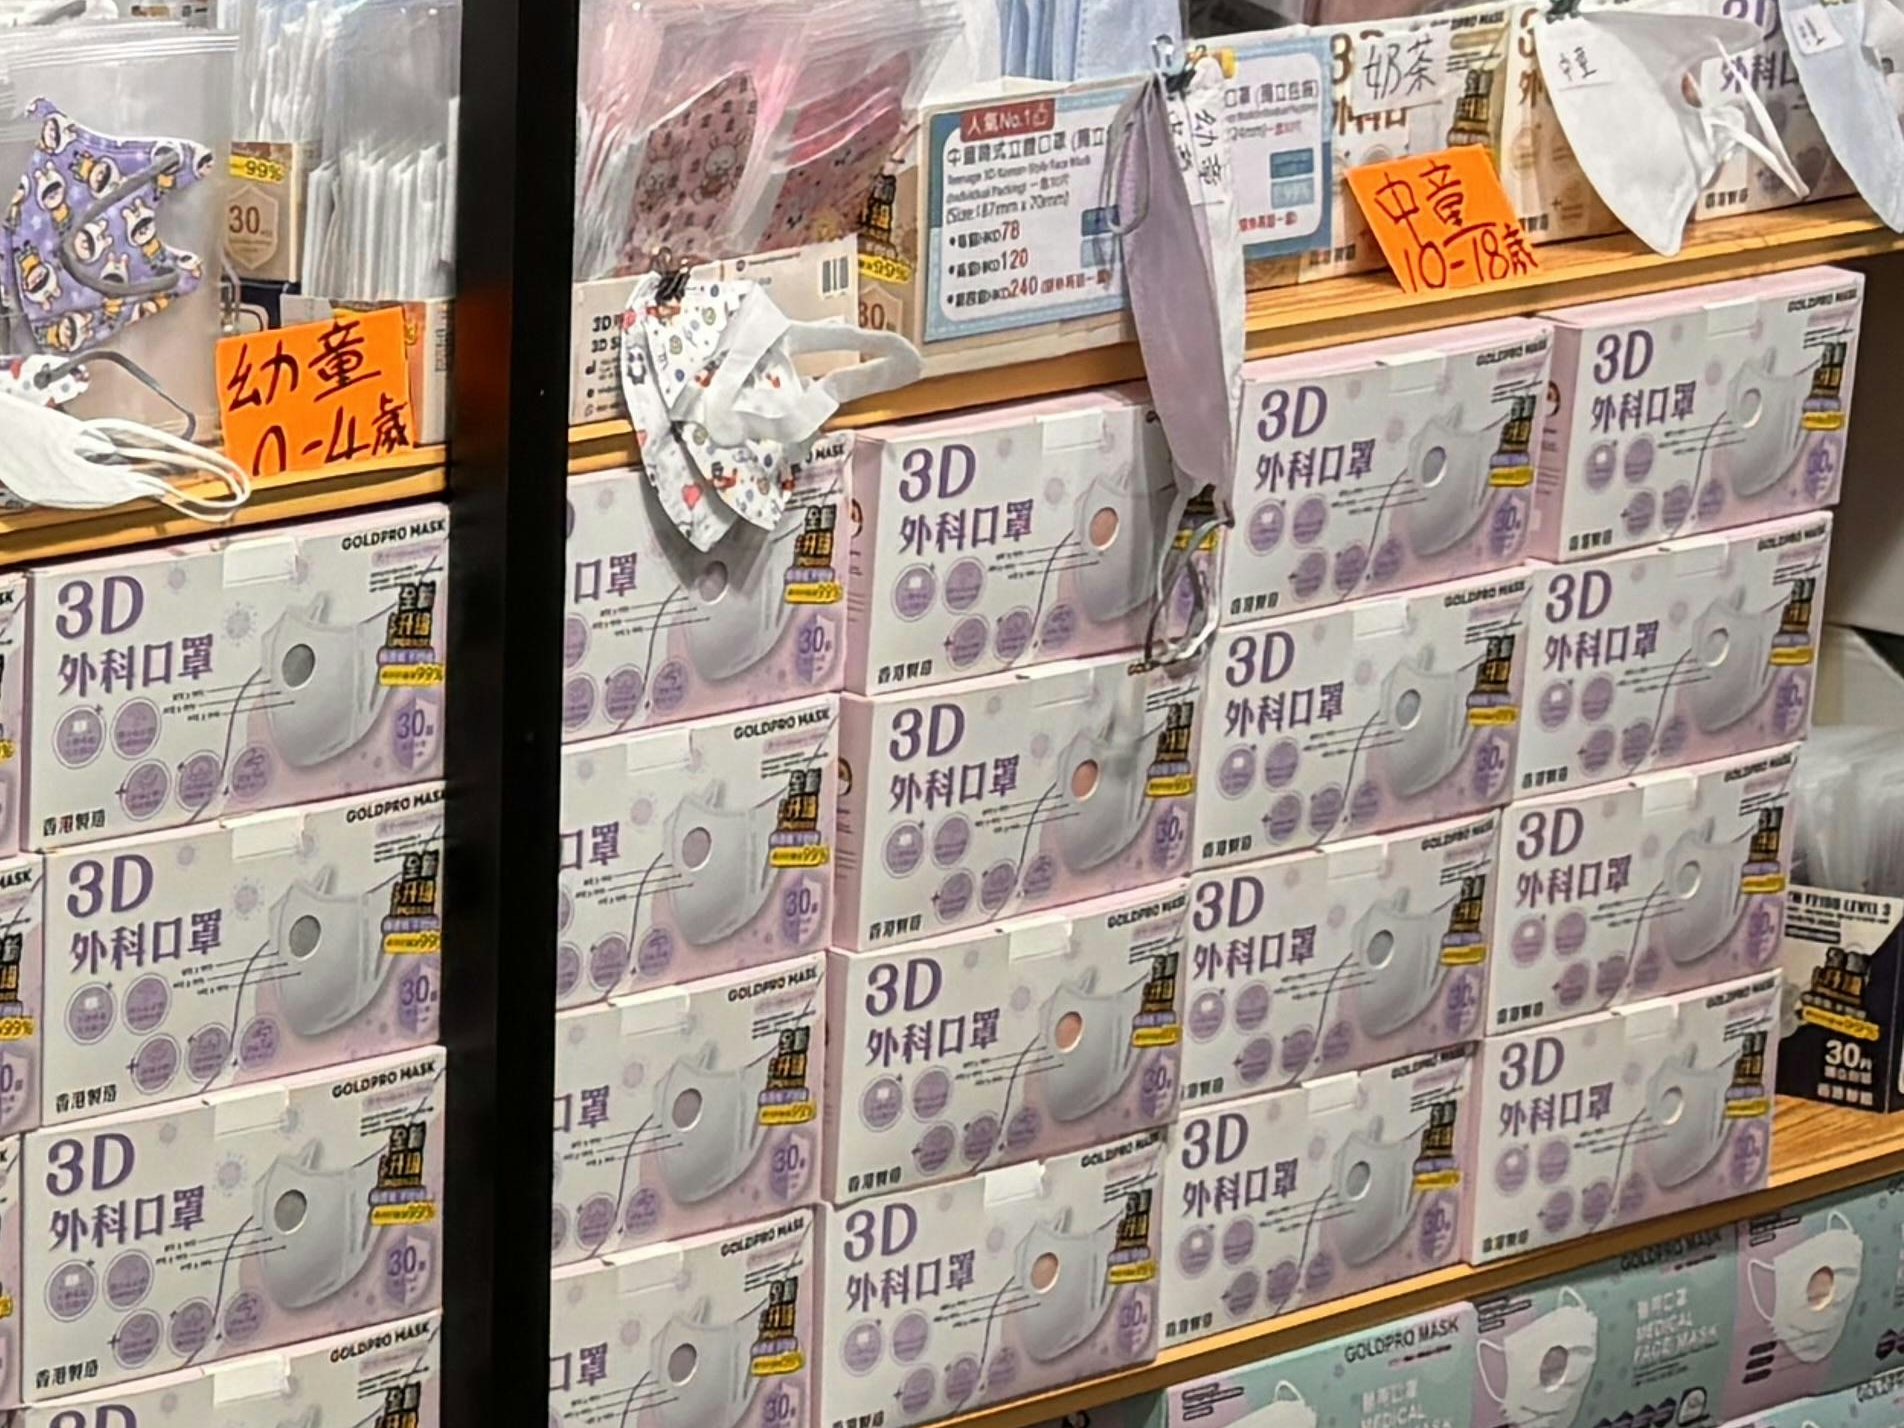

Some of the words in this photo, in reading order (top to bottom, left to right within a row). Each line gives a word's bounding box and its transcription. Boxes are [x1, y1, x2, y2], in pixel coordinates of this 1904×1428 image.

[1363, 33, 1437, 101] 奶茶
[1374, 160, 1497, 249] 中童
[1404, 222, 1539, 289] 10-18歲
[227, 318, 382, 413] 幼童
[1255, 385, 1328, 444] 3D
[1591, 381, 1698, 432] 外科口罩
[342, 527, 408, 551] GOLDPRO
[409, 518, 447, 539] MASK
[899, 499, 1035, 556] 外科口罩
[58, 633, 215, 697] 外科口罩
[1181, 1157, 1300, 1217] 外科口罩
[1344, 1326, 1417, 1365] GOLDPRO
[1418, 1313, 1461, 1345] MASK
